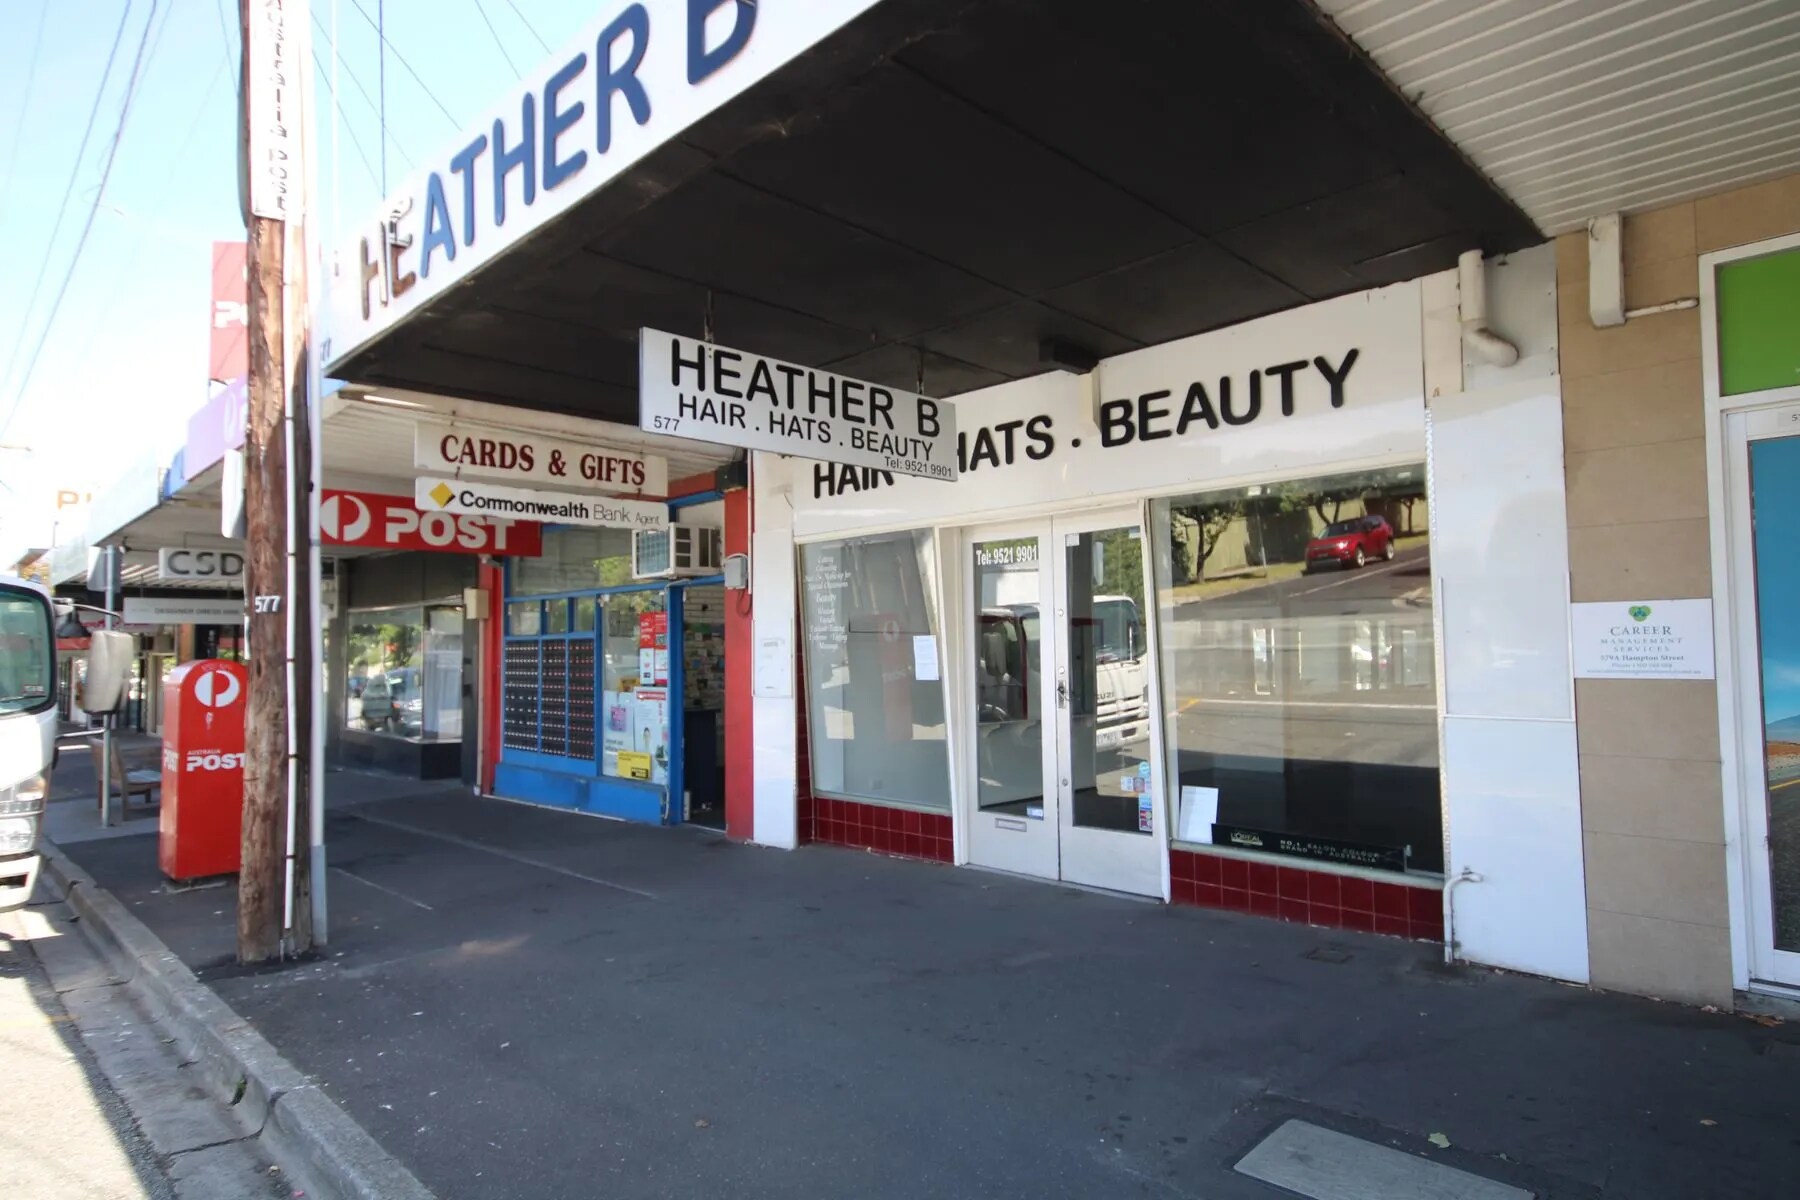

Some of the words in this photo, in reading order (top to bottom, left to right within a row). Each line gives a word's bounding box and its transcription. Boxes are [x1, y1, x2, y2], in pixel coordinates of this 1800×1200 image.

[360, 2, 652, 320] HEATHER
[671, 338, 894, 430] HEATHER
[917, 397, 941, 438] B
[1101, 347, 1360, 448] BEAUTY
[653, 415, 680, 432] 577
[678, 392, 746, 429] HAIR
[769, 409, 832, 443] HATS
[851, 427, 934, 462] BEAUTY
[440, 434, 535, 472] CARDS
[548, 449, 567, 477] &
[580, 453, 646, 486] GIFTS
[884, 455, 903, 469] Tel:
[905, 459, 928, 473] 9521
[930, 463, 952, 478] 9901
[459, 490, 589, 520] Commonwealth
[593, 503, 631, 522] Bank
[635, 511, 661, 527] Agent
[386, 507, 517, 550] POST
[976, 550, 992, 566] Tel:
[993, 546, 1014, 564] 9521
[1016, 544, 1037, 562] 9901
[255, 595, 281, 613] 577
[1600, 637, 1683, 645] MANAGEMENT
[1610, 625, 1672, 637] CAREER
[1613, 645, 1670, 653] SERVICES
[1622, 654, 1659, 662] Hampton
[186, 752, 247, 772] POST
